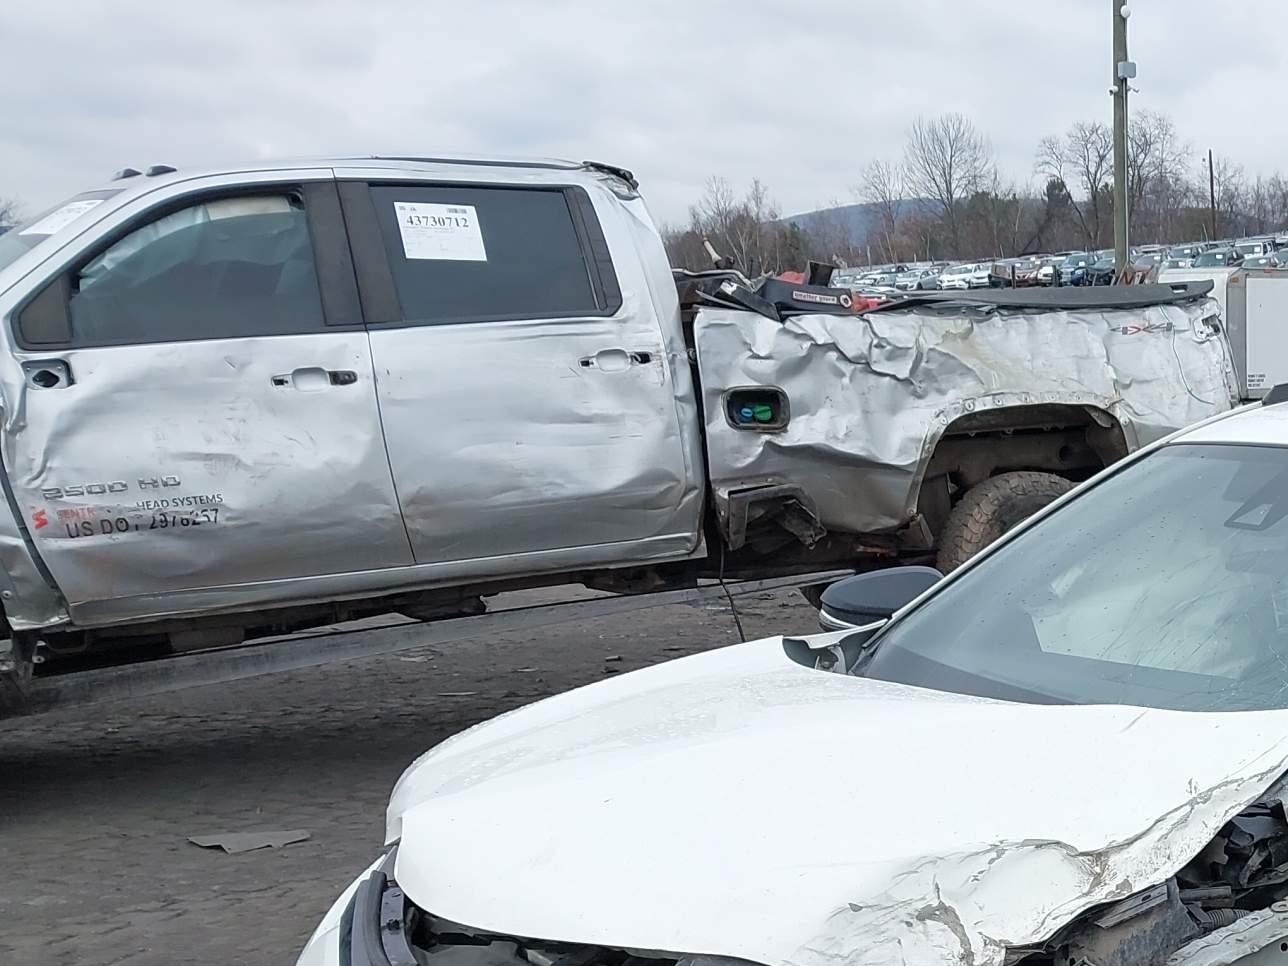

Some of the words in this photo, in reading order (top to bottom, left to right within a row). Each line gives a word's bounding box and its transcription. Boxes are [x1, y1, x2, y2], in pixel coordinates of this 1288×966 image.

[406, 215, 470, 228] 43730712
[138, 476, 181, 490] HD
[172, 493, 223, 507] SYSTEMS
[65, 521, 95, 539] US
